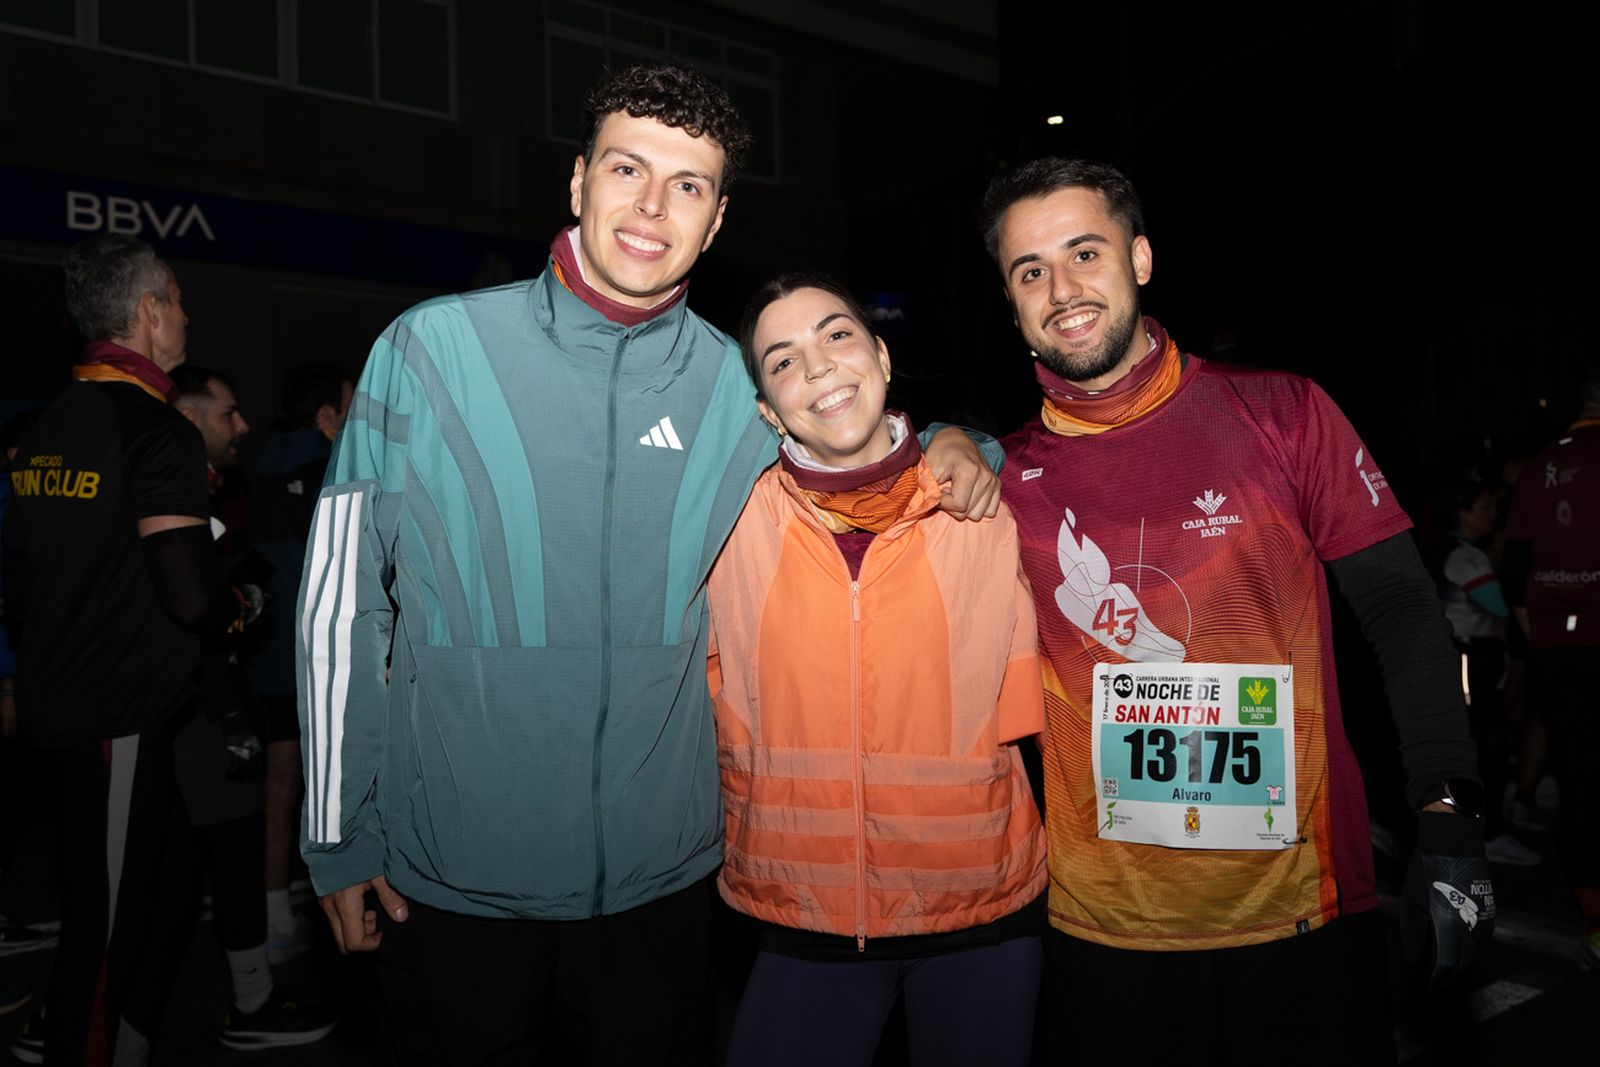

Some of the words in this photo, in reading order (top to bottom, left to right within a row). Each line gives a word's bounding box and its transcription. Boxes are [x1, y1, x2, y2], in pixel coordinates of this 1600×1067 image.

[65, 189, 216, 242] BBVA
[11, 468, 41, 497] RUN
[43, 468, 101, 499] CLUB
[1182, 518, 1206, 530] CAJA
[1208, 515, 1243, 526] RURAL
[1092, 598, 1140, 646] 43
[1114, 679, 1133, 692] 43
[1136, 683, 1193, 701] NOCHE
[1197, 684, 1220, 701] DE
[1115, 704, 1150, 723] SAN
[1153, 701, 1220, 725] ANTÓN
[1123, 728, 1261, 785] 13175
[1172, 787, 1212, 803] Alvaro
[1449, 890, 1466, 905] 43
